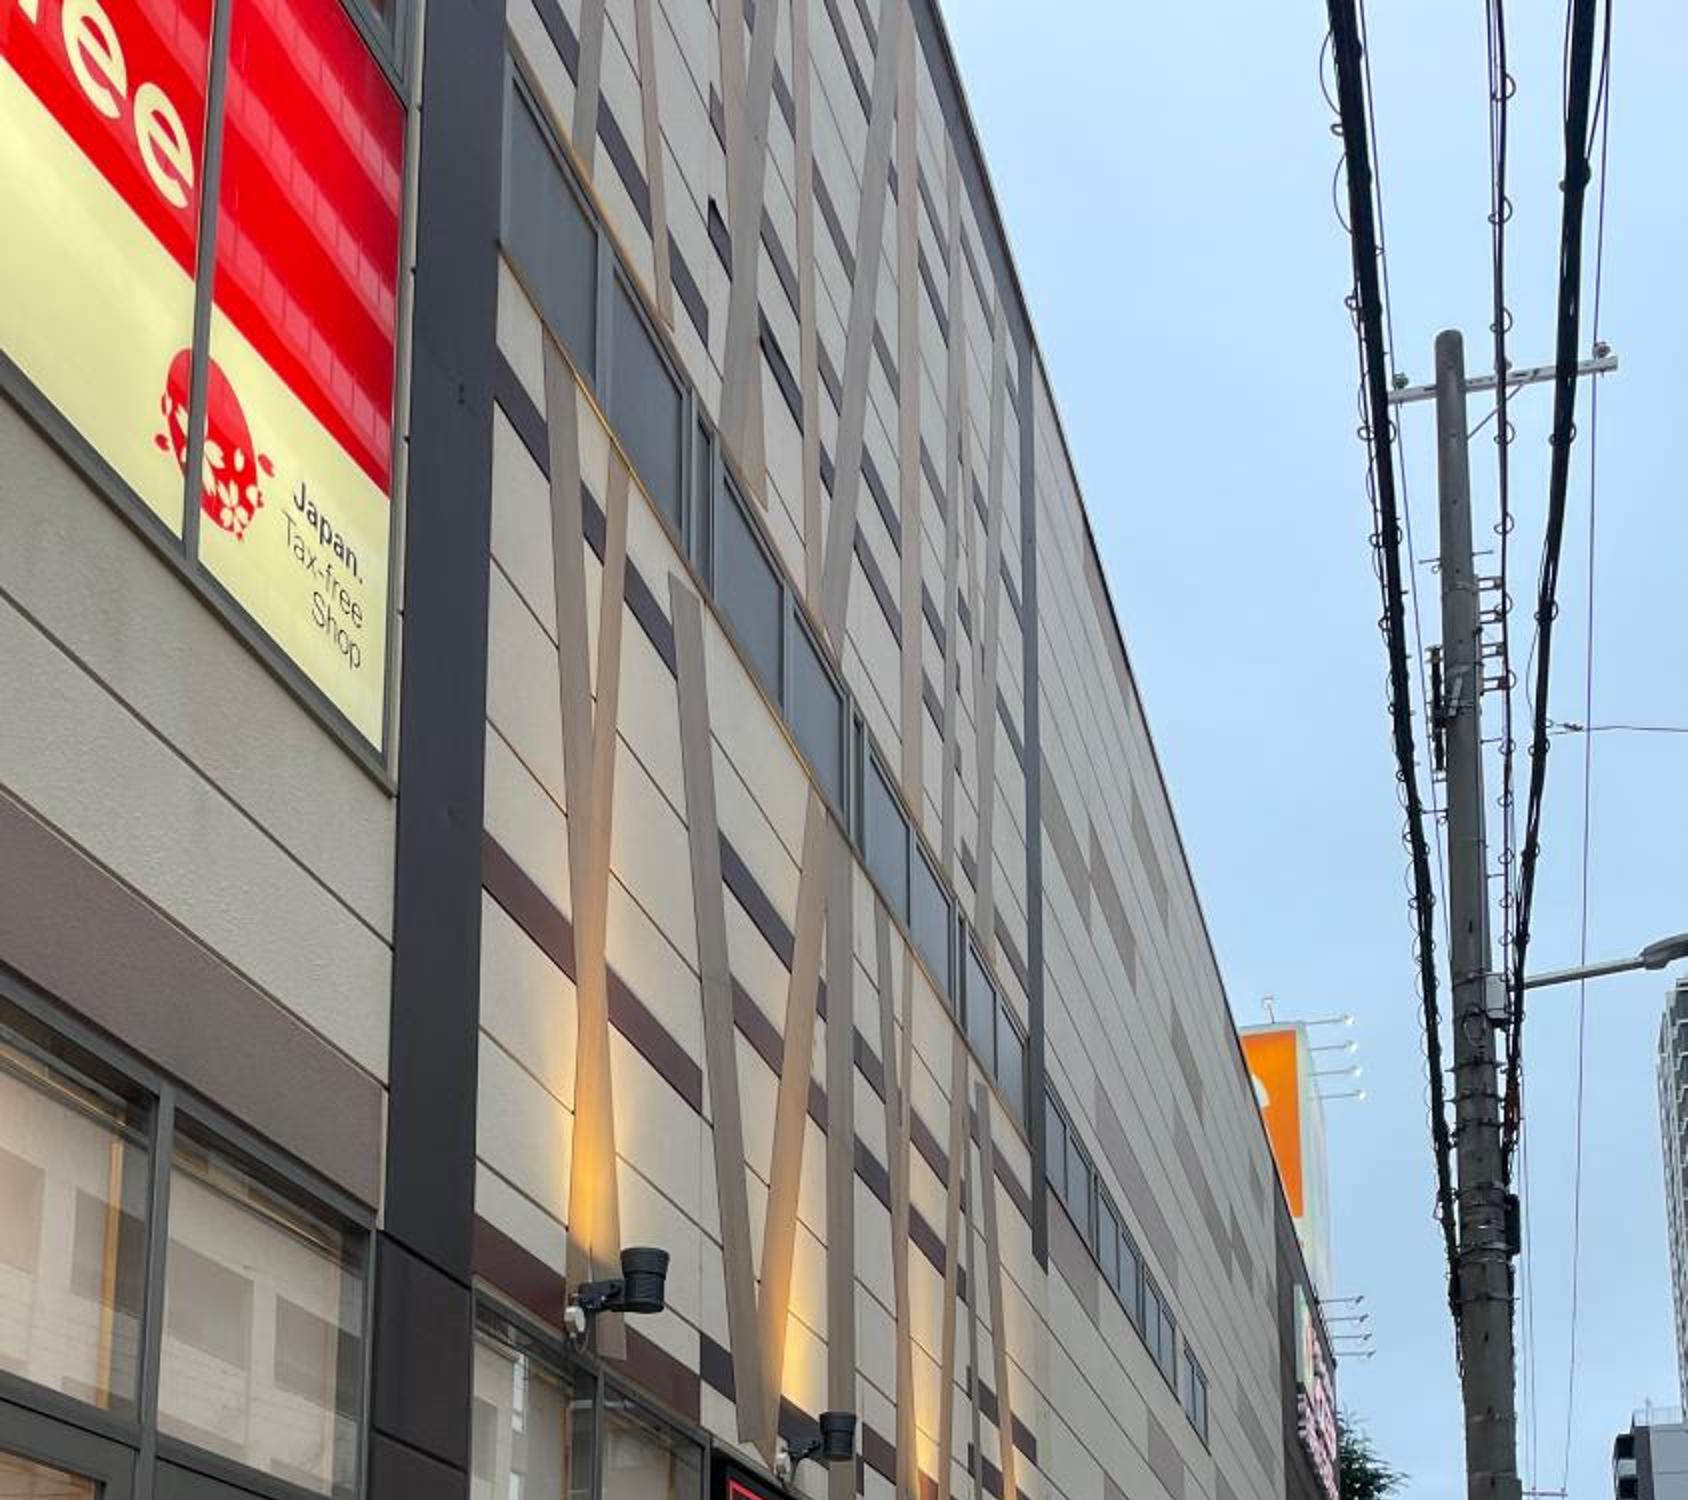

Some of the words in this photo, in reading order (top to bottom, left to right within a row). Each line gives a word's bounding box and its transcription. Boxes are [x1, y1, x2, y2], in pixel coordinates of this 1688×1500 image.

[17, 0, 194, 208] ee
[282, 509, 363, 629] Tax-free
[293, 482, 363, 585] Japan.
[311, 591, 361, 672] Shop
